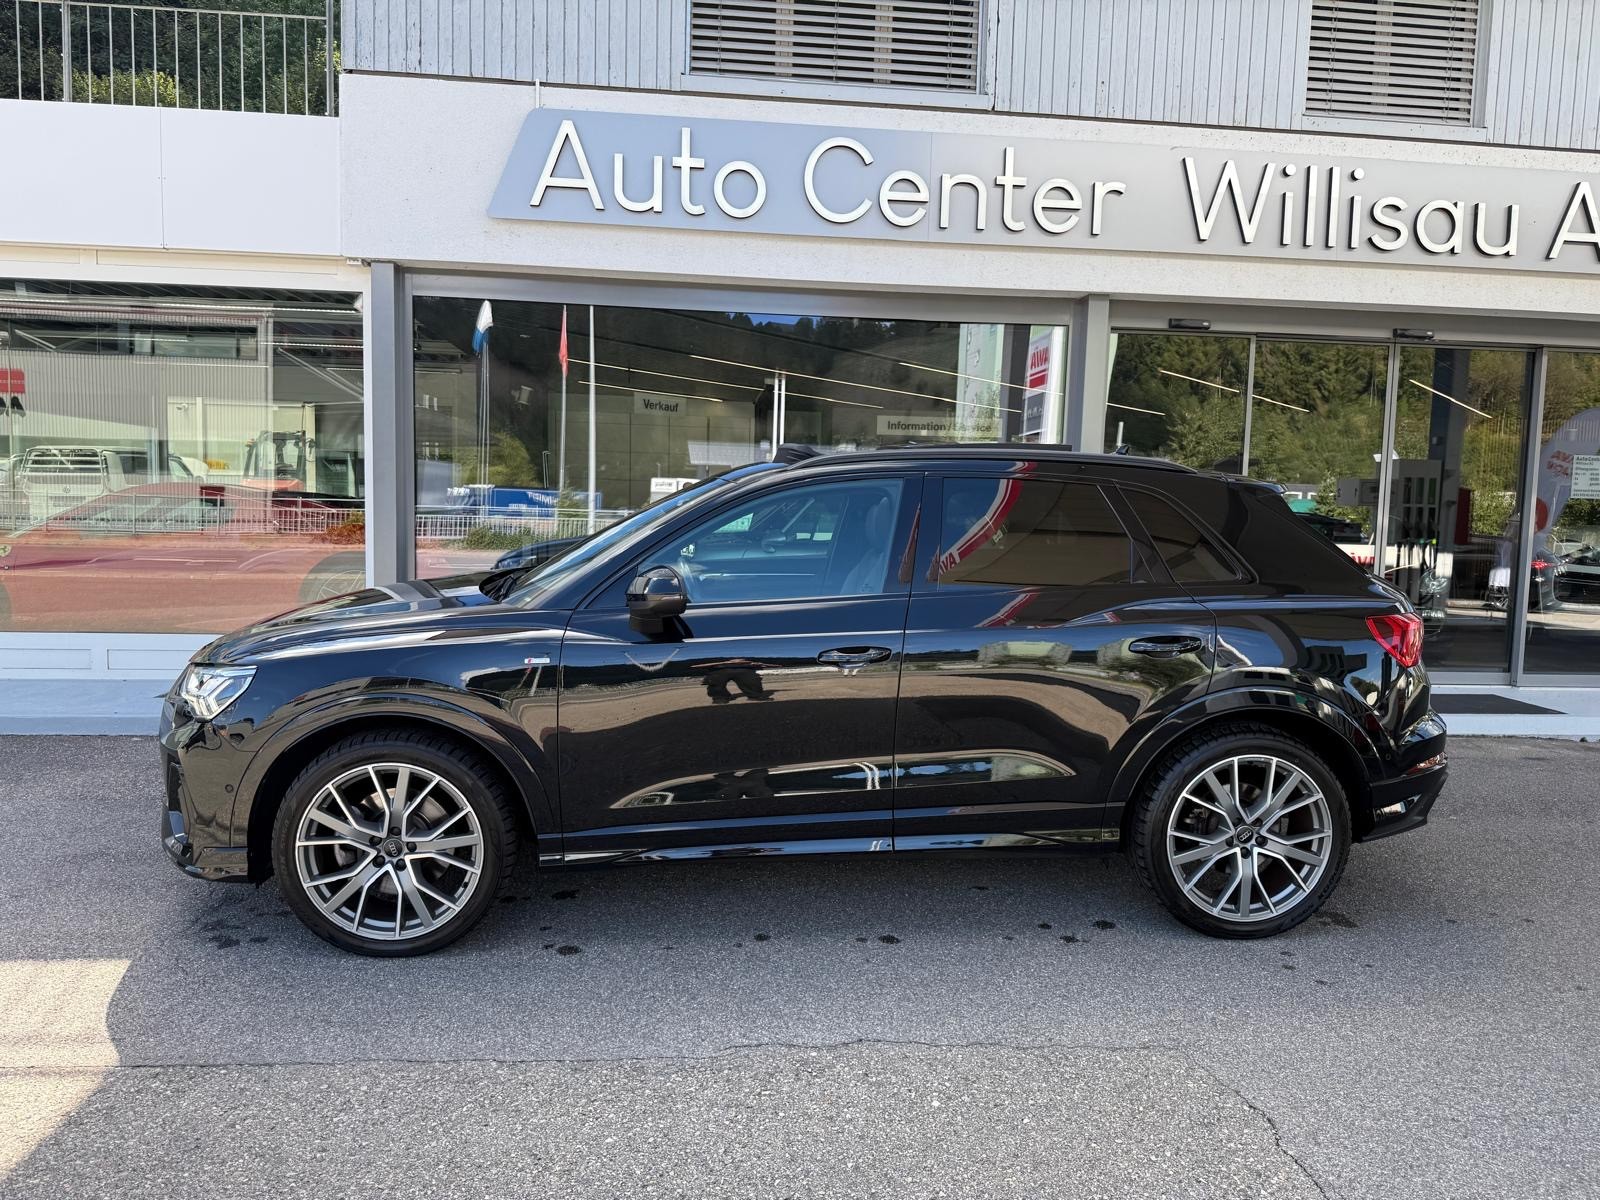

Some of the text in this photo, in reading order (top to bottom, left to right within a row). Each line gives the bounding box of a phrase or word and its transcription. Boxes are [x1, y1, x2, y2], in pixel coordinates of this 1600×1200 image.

[529, 119, 767, 220] Auto
[803, 136, 1127, 236] Center
[1182, 157, 1520, 256] Willisau
[643, 398, 679, 413] Verkauf
